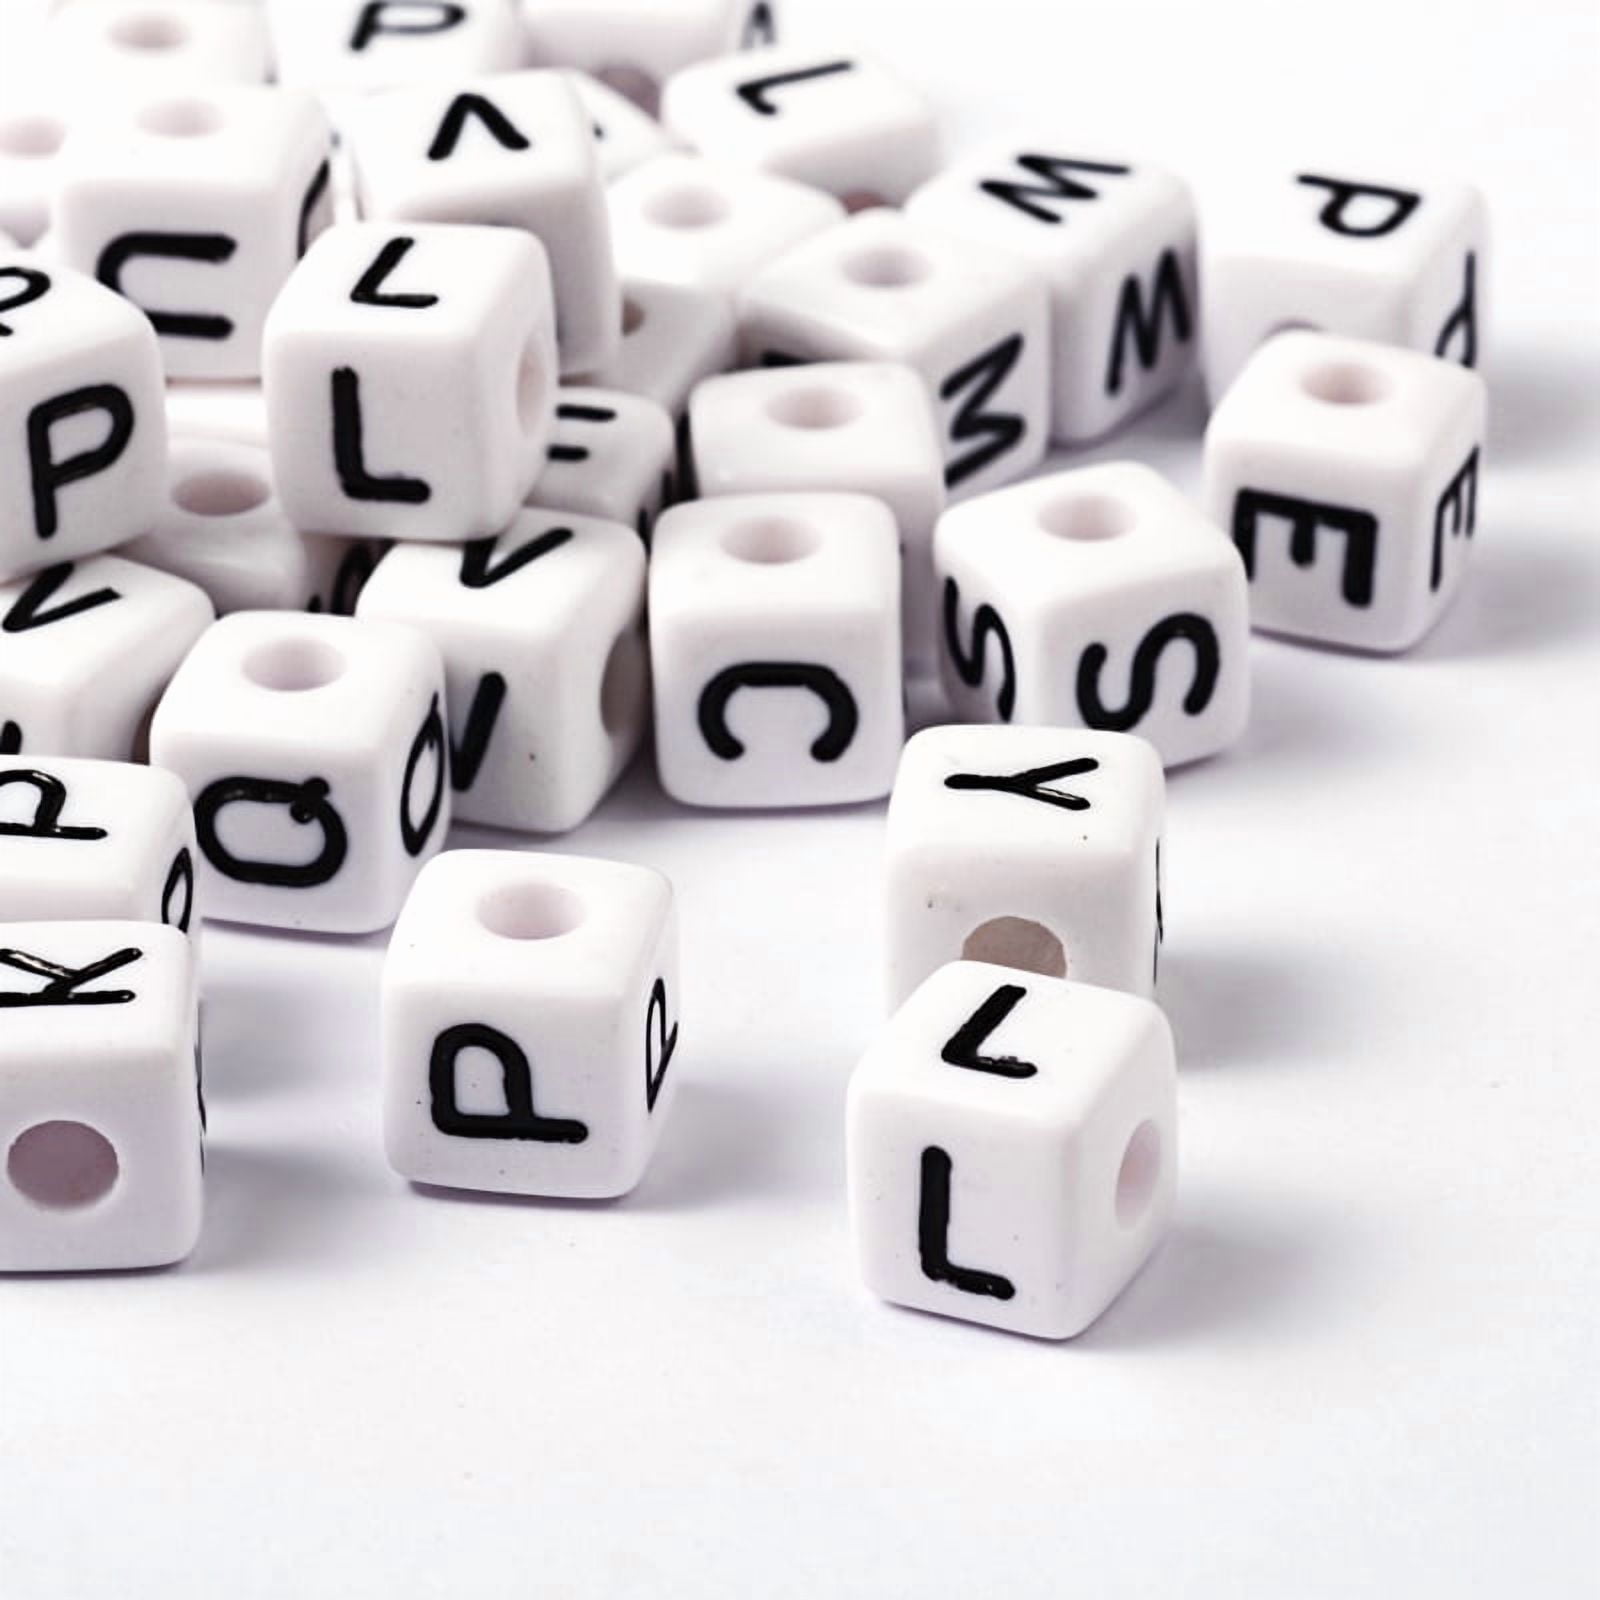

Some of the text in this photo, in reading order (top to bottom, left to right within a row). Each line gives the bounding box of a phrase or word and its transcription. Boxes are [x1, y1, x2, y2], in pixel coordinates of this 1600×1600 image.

[1296, 174, 1420, 238] P
[350, 237, 439, 309] L
[27, 383, 136, 541] P
[331, 366, 432, 505] L
[1232, 487, 1379, 609] E
[943, 576, 1016, 724] S
[1075, 612, 1221, 732] S
[697, 661, 859, 763] C
[193, 775, 349, 889] Q
[944, 757, 1099, 811] Y
[0, 947, 144, 1008] K
[940, 984, 1038, 1079] L
[428, 1022, 589, 1145] P
[918, 1145, 1016, 1301] L
